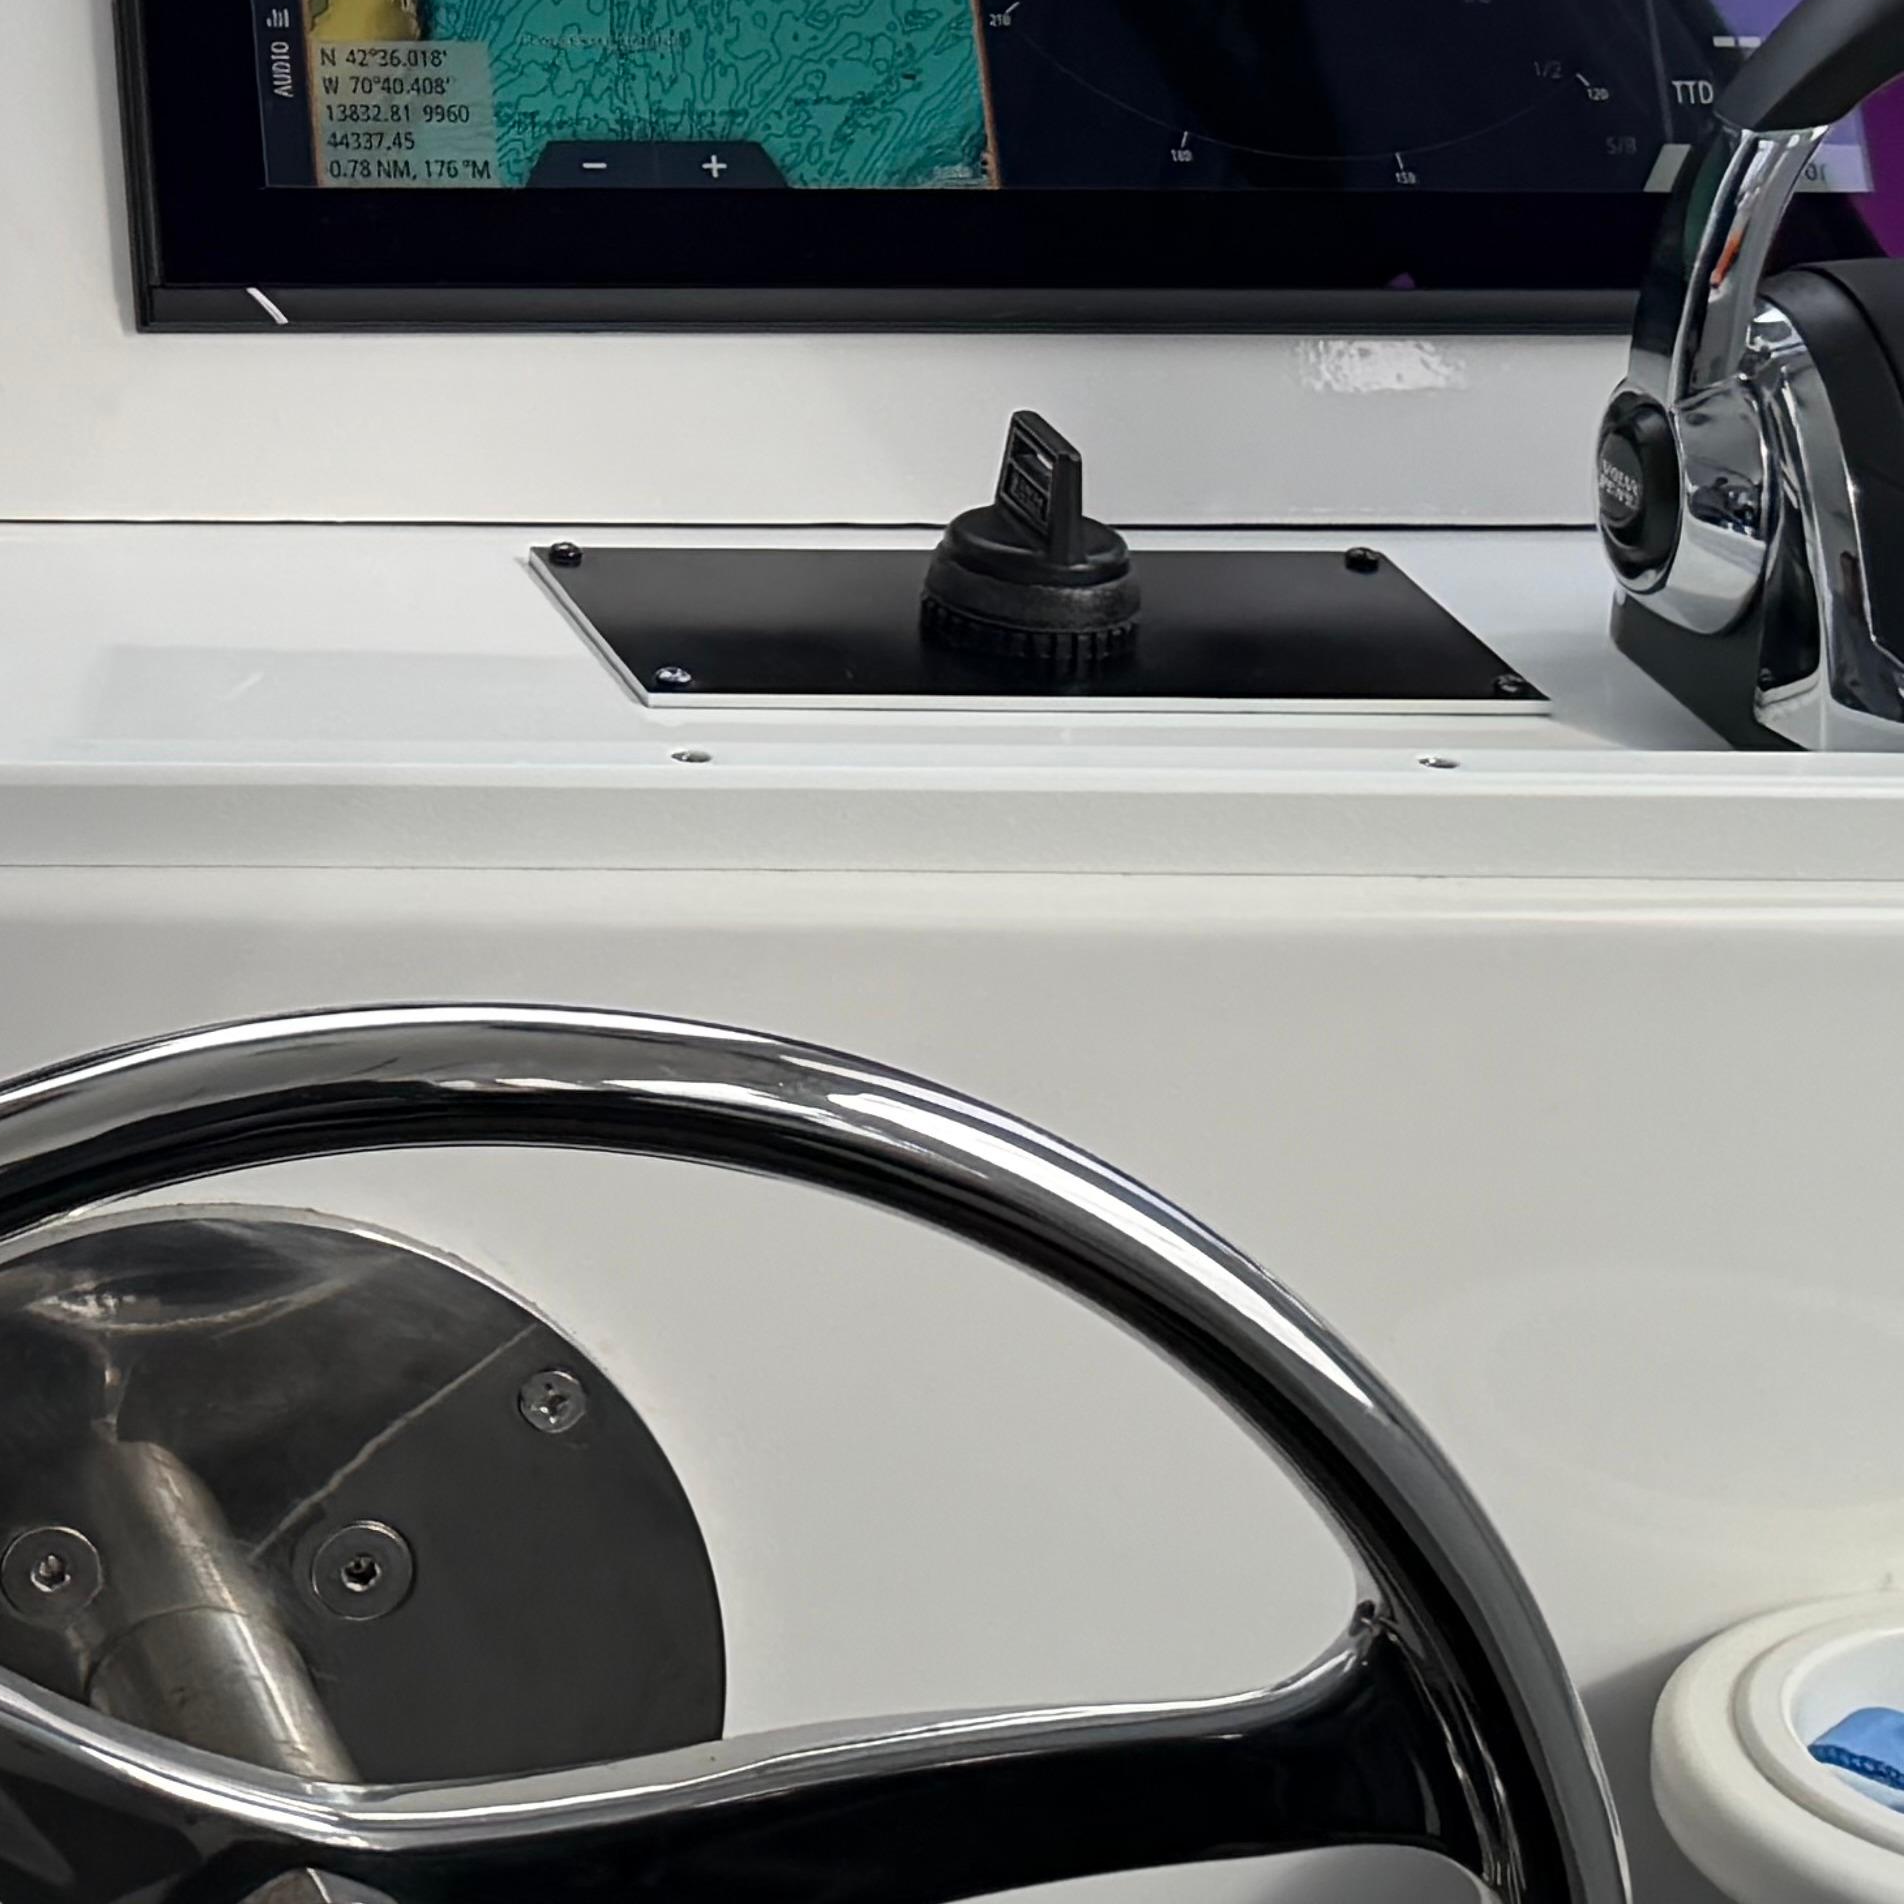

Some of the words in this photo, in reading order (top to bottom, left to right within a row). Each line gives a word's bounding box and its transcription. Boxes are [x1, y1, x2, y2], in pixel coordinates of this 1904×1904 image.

[320, 49, 337, 67] N
[271, 40, 294, 98] AUDIO
[322, 77, 340, 95] W
[1672, 79, 1714, 105] TTD
[326, 104, 412, 124] 13832.81
[423, 104, 470, 124] 9960
[326, 132, 416, 152] 44337.45
[329, 159, 373, 180] 0.78
[376, 159, 419, 183] NM,
